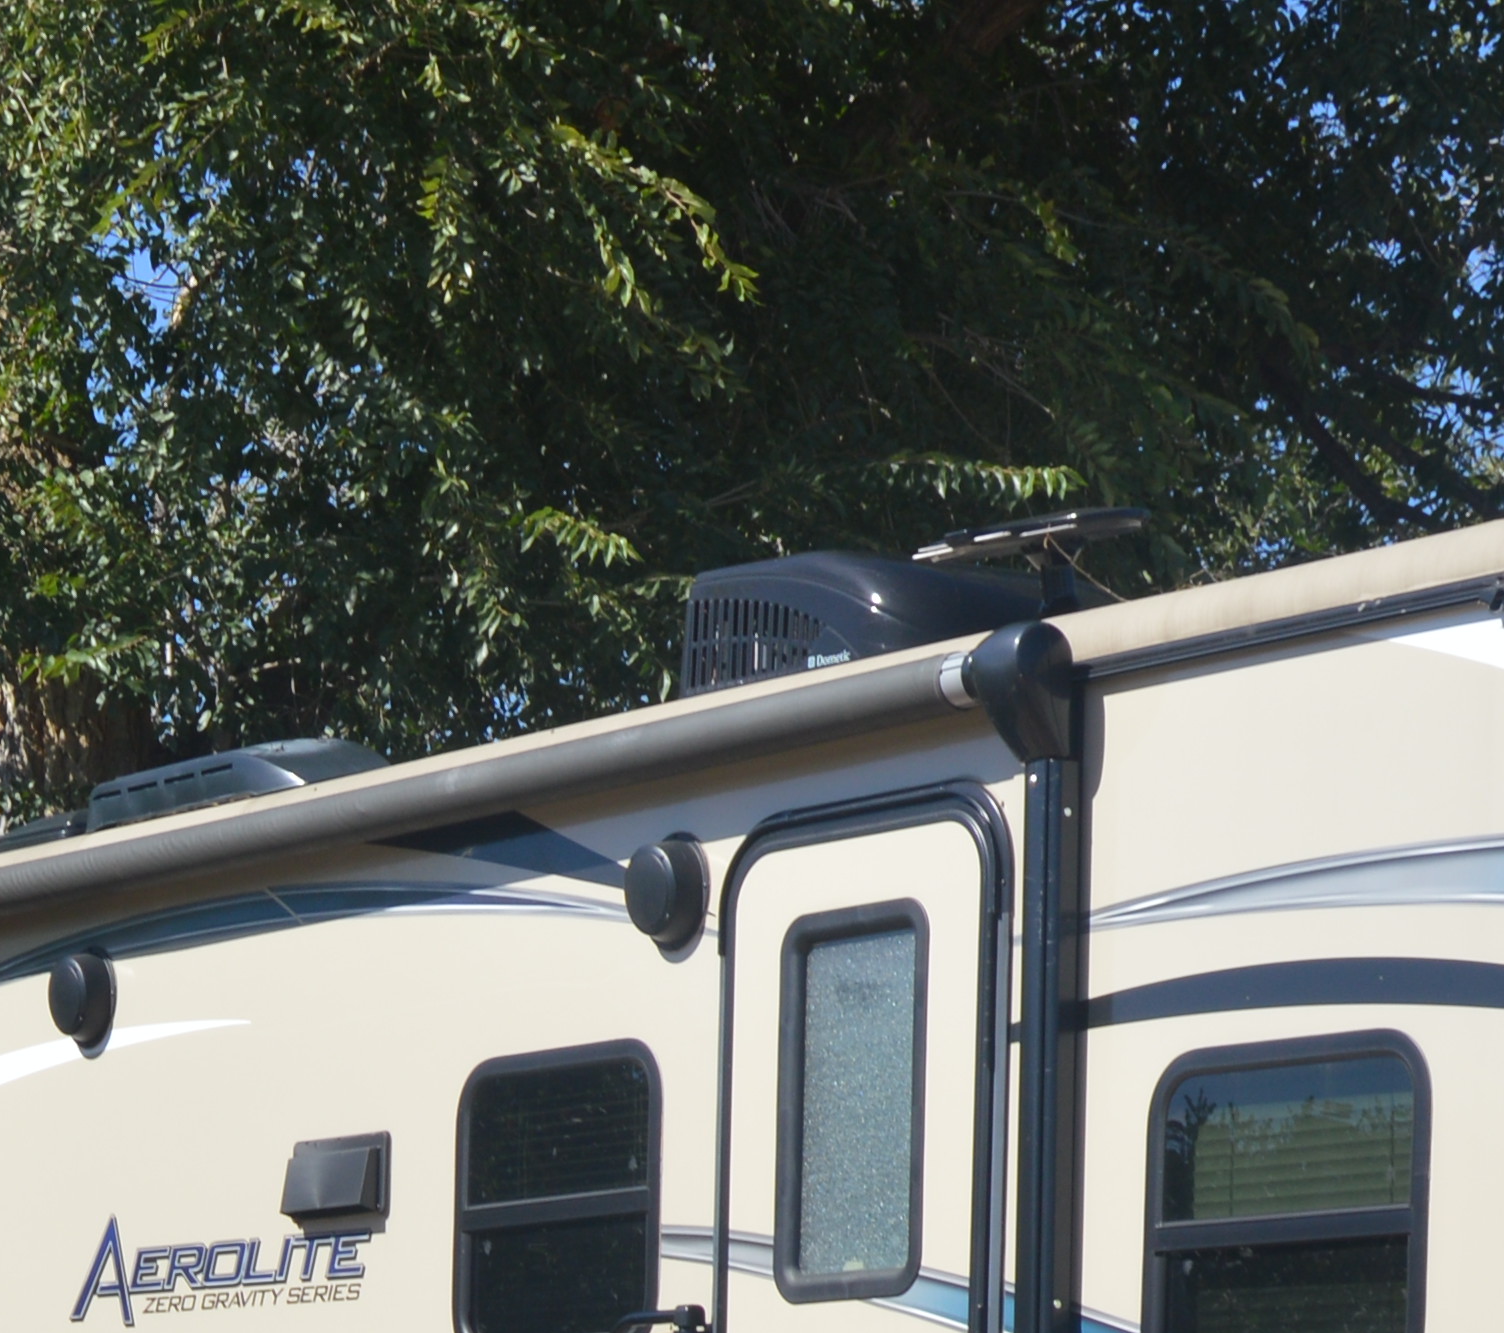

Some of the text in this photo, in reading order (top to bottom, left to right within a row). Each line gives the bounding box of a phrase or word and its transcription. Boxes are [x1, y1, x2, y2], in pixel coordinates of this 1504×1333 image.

[816, 648, 851, 668] Dometic
[142, 1283, 362, 1314] ZERO GRAVITY SERIES
